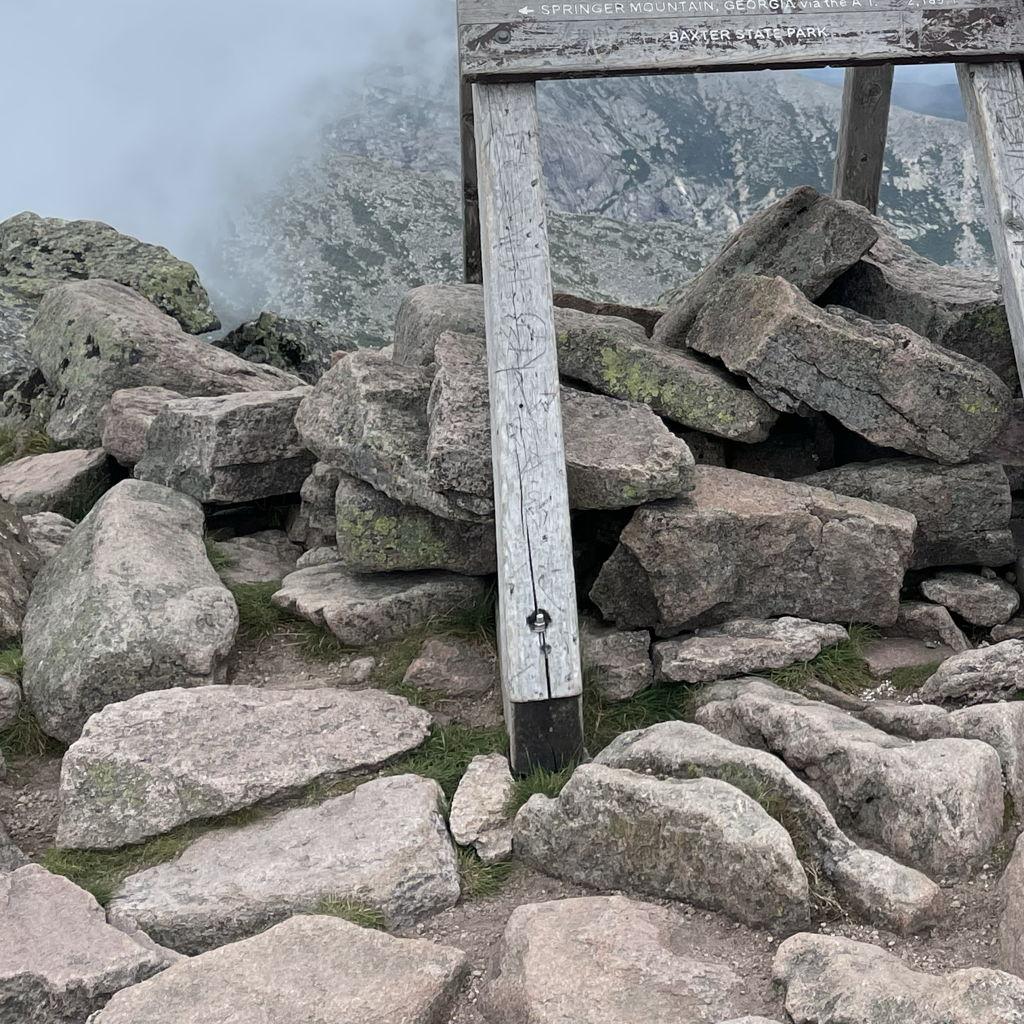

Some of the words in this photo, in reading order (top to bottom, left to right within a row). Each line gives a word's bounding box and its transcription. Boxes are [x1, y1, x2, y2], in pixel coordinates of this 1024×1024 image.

[541, 3, 625, 15] SPRINGER
[724, 0, 796, 11] GEORGIA
[800, 0, 821, 8] via
[669, 29, 731, 42] BAXTER
[735, 28, 784, 40] STATE
[787, 26, 828, 38] PARK
